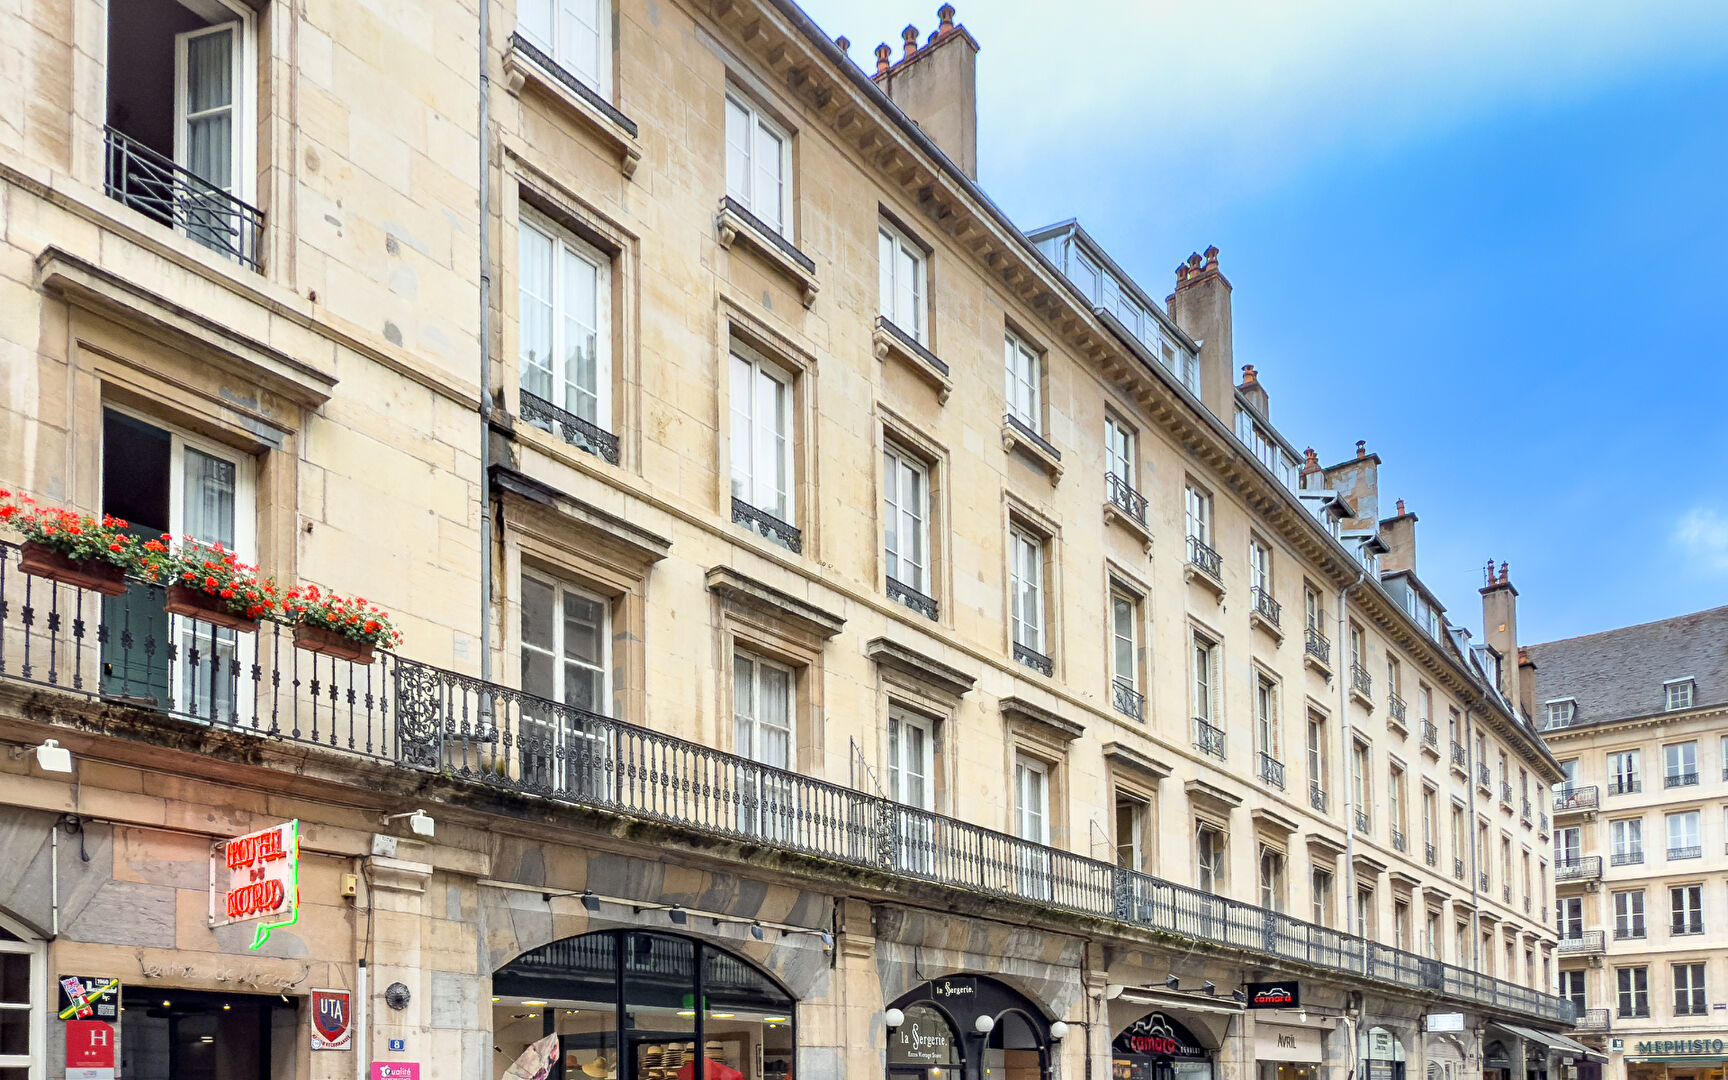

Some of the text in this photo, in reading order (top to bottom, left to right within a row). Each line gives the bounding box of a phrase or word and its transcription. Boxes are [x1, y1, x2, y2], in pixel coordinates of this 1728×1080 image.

[227, 879, 284, 917] NORD
[936, 986, 943, 995] la
[1254, 995, 1292, 1003] camara
[320, 998, 343, 1024] UTA
[90, 1030, 107, 1046] H
[394, 1040, 400, 1049] 8
[901, 1031, 909, 1044] la
[1130, 1036, 1177, 1053] camara
[1639, 1038, 1724, 1054] MEPHISTO
